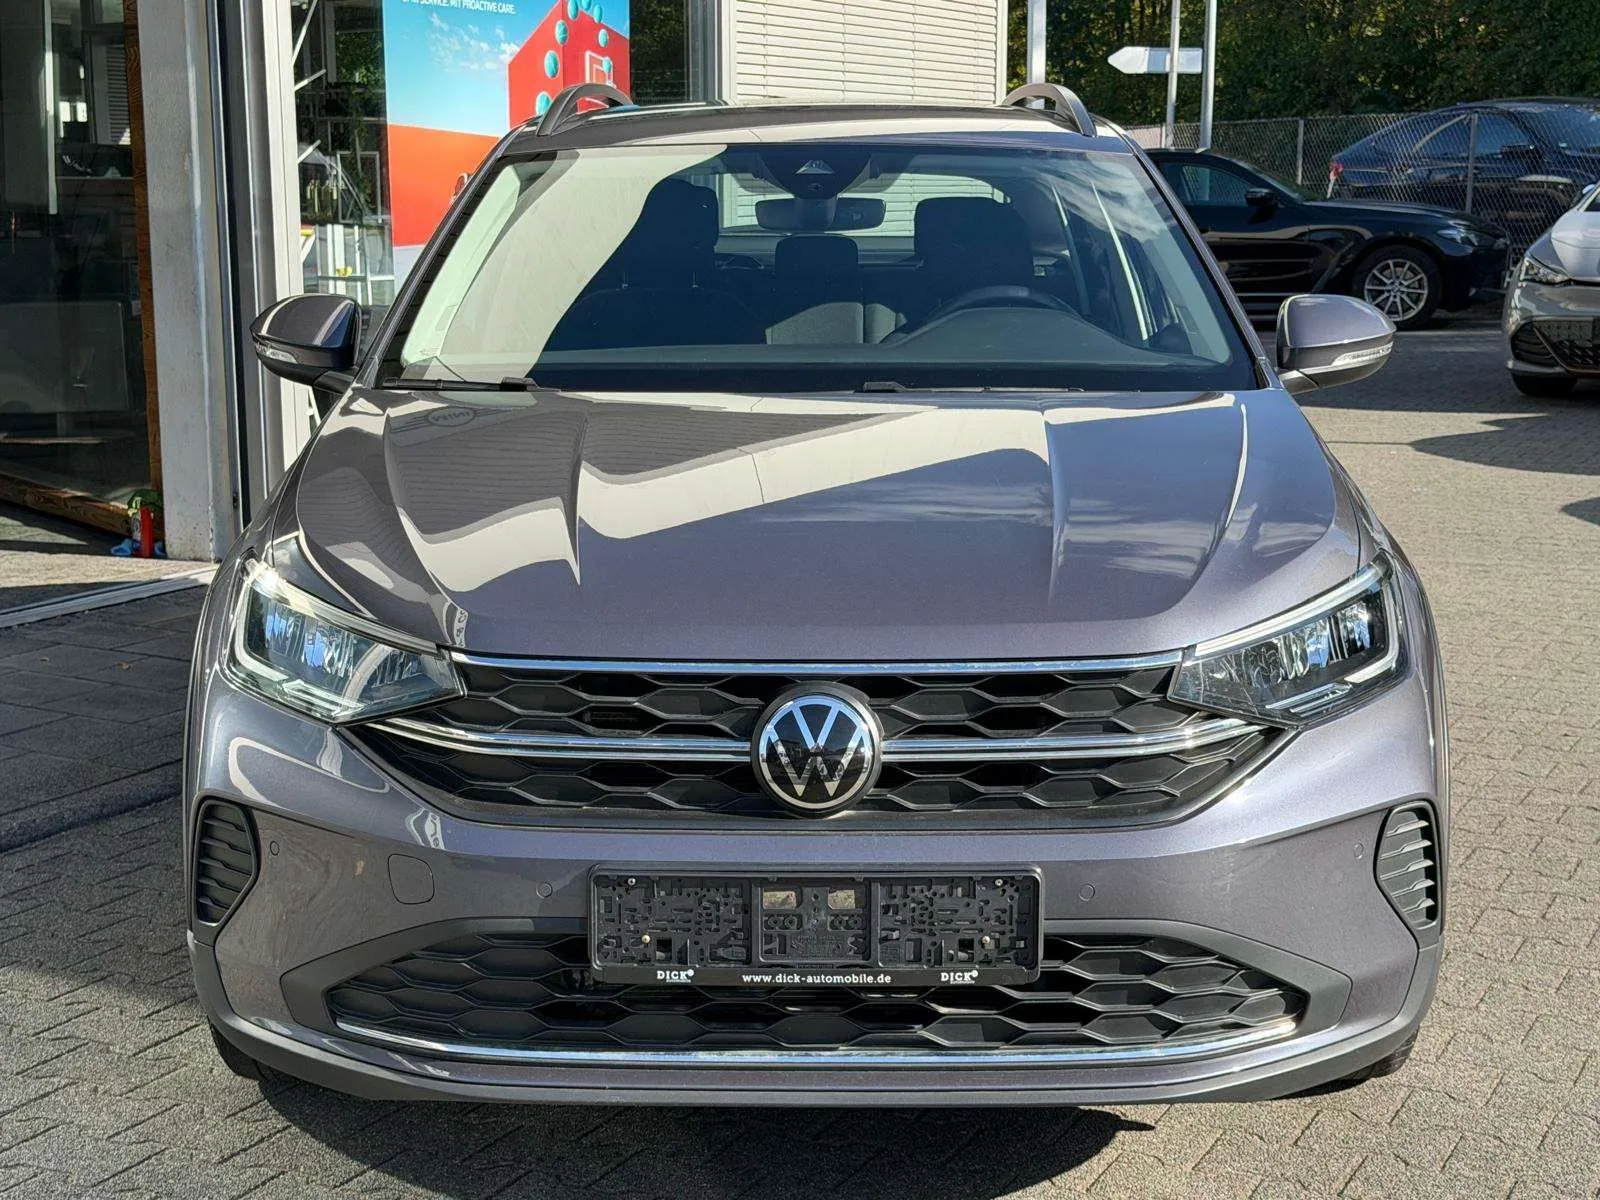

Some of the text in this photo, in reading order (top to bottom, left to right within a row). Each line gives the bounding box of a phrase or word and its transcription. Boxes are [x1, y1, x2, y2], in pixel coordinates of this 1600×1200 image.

[463, 0, 497, 12] PROACTIVE
[656, 970, 689, 980] DICK
[742, 973, 892, 984] www.dick-automobile.de
[940, 971, 972, 981] DICK
